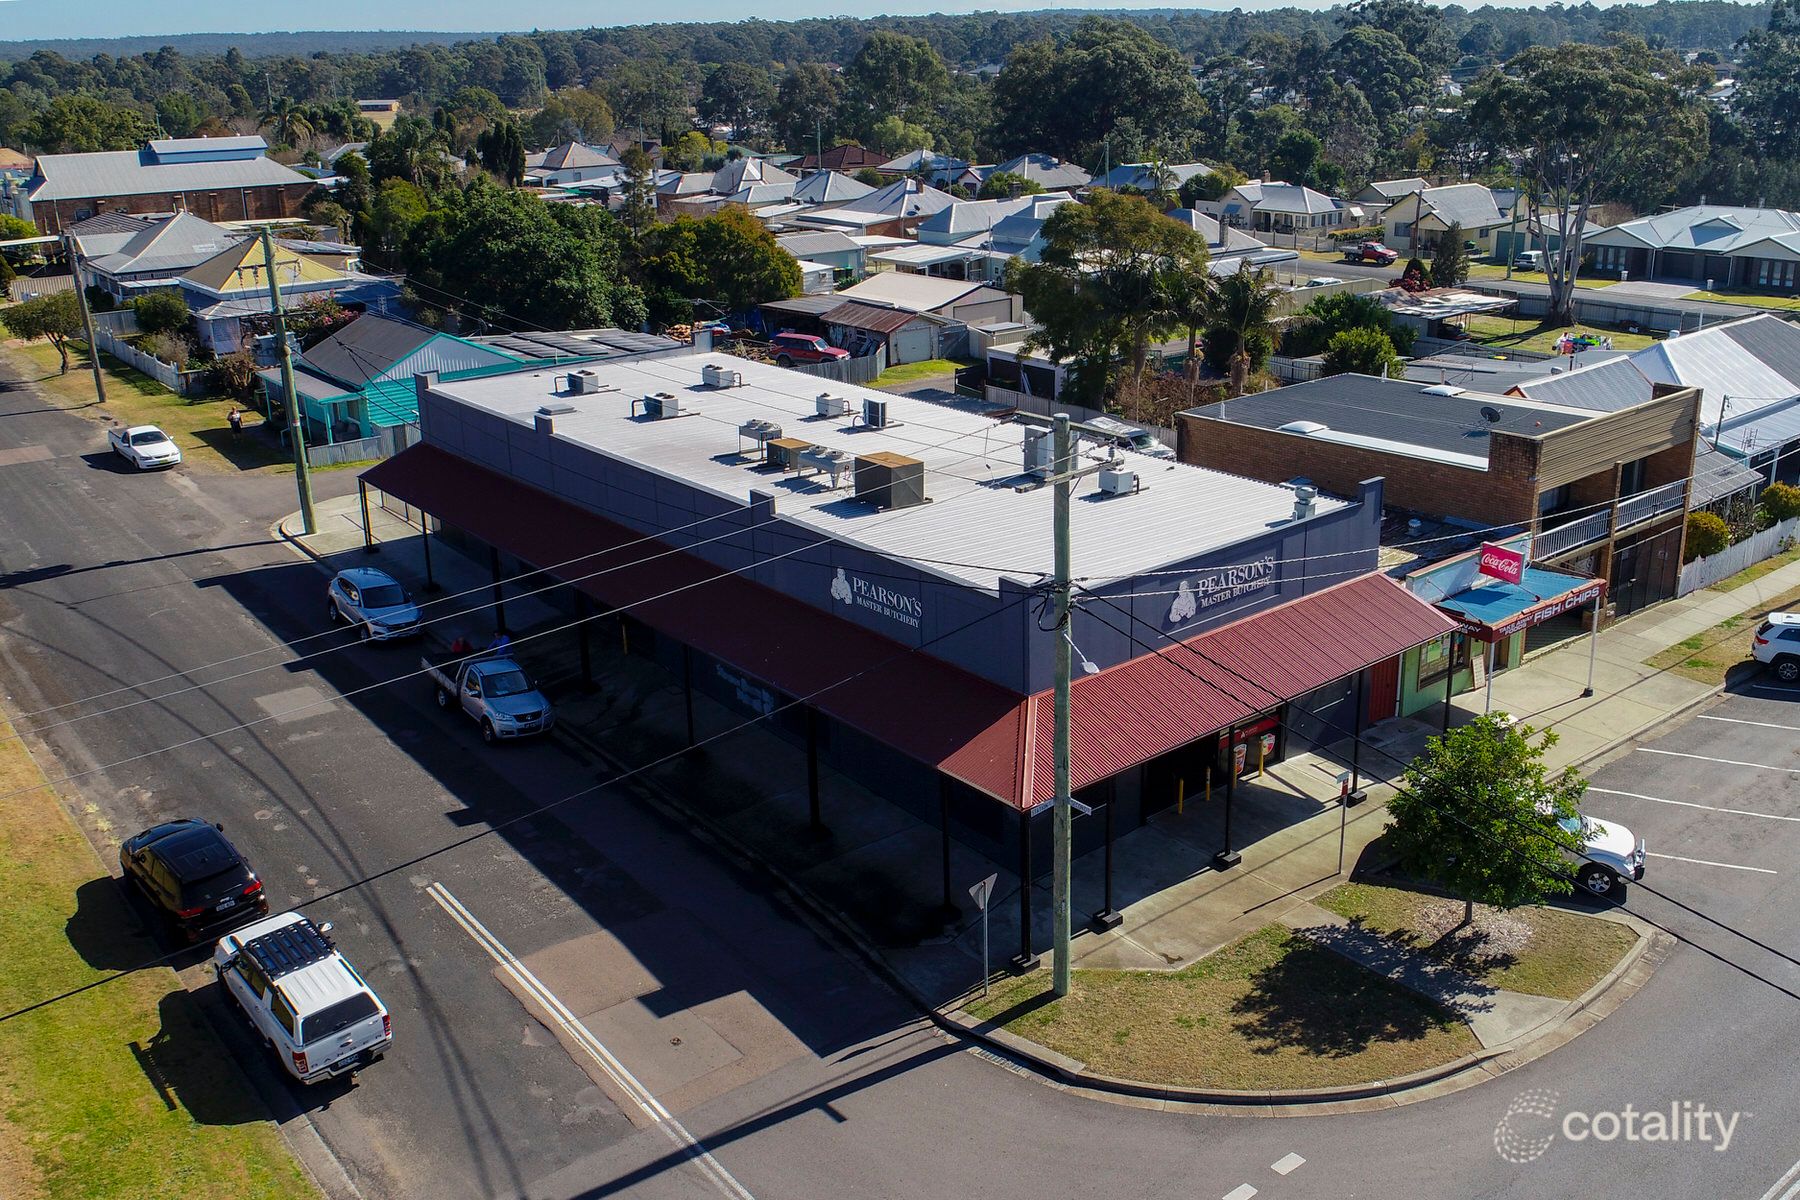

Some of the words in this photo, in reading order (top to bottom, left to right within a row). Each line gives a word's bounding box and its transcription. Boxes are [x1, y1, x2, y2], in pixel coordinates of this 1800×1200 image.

[1197, 556, 1274, 597] PEARSON'S
[1481, 553, 1520, 575] Coca-Cola
[852, 577, 922, 617] PEARSON'S
[857, 596, 883, 614] MASTER
[884, 608, 920, 628] BUTCHERY
[1201, 592, 1231, 608] MASTER
[1534, 603, 1562, 623] FISH
[1565, 586, 1600, 609] CHIPS
[1459, 621, 1482, 633] WAY
